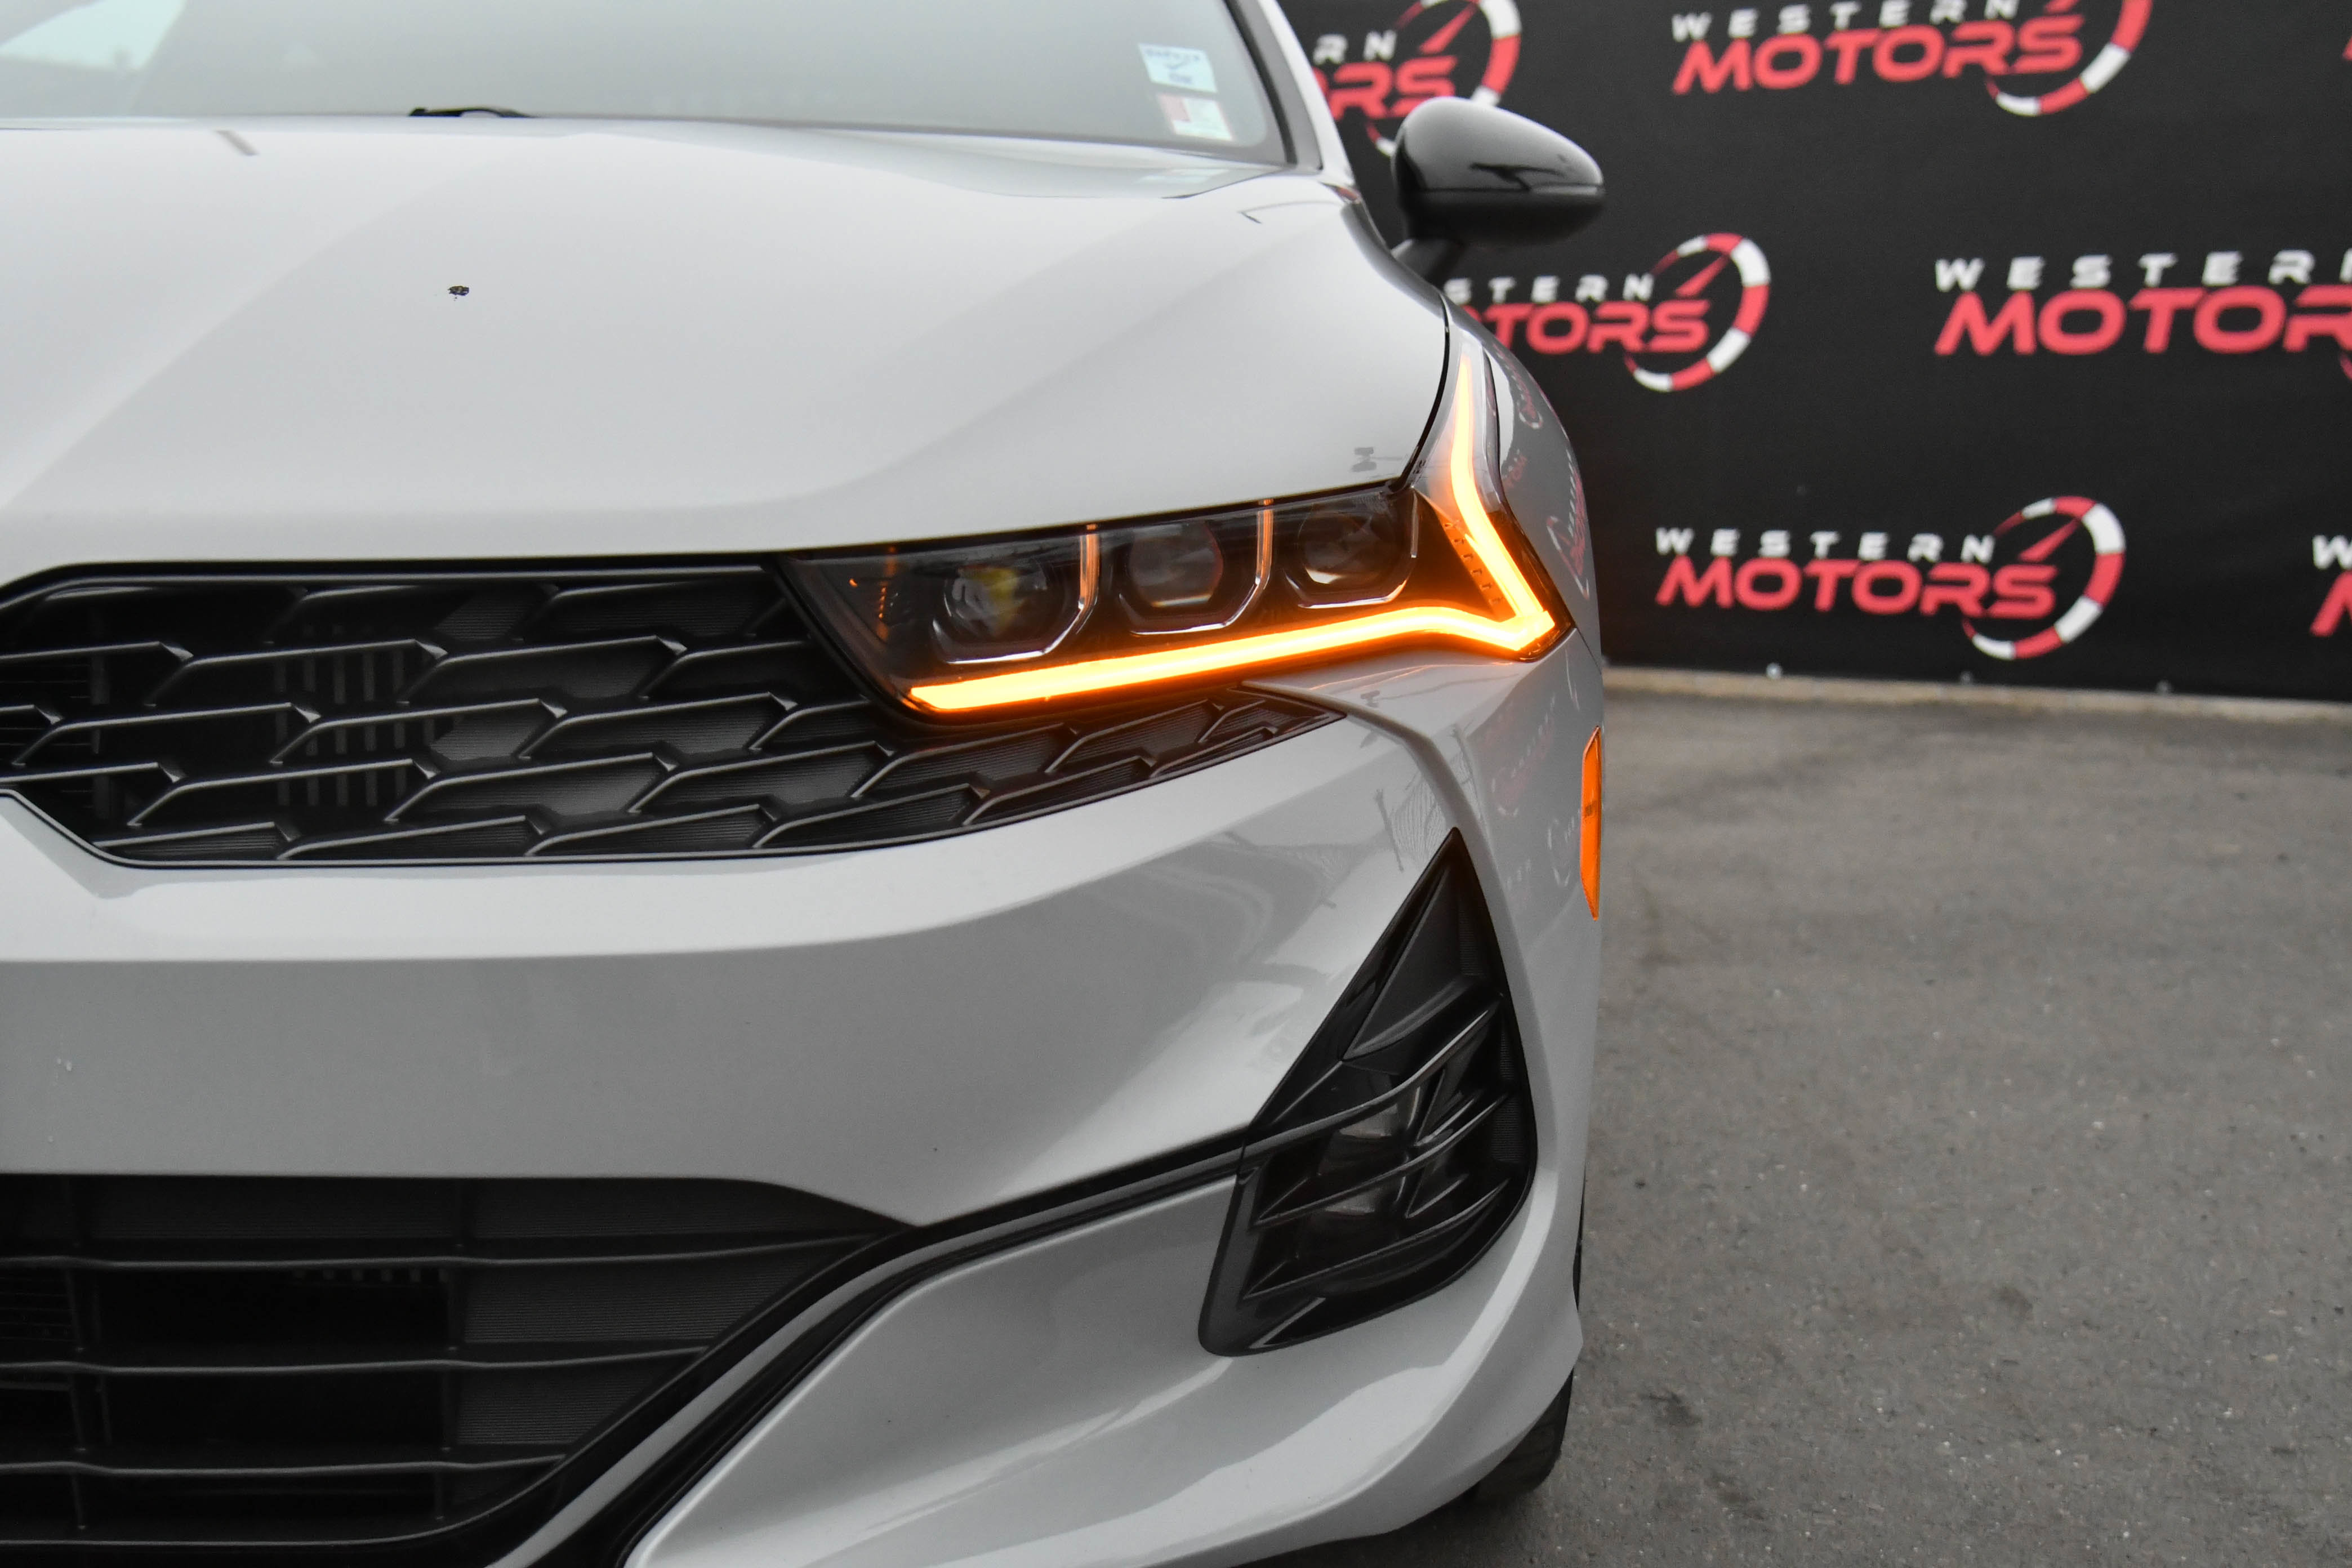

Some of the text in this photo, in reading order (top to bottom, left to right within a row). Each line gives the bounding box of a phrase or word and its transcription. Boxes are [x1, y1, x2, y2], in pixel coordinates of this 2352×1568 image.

[1671, 0, 2020, 42] WESTERN
[1672, 14, 2084, 95] MOTORS
[1444, 274, 1655, 304] STERN
[1460, 299, 1710, 354] TORS
[1934, 284, 2352, 355] MOTOR
[1655, 527, 1995, 563] WESTERN
[1655, 555, 2057, 618] MOTORS
